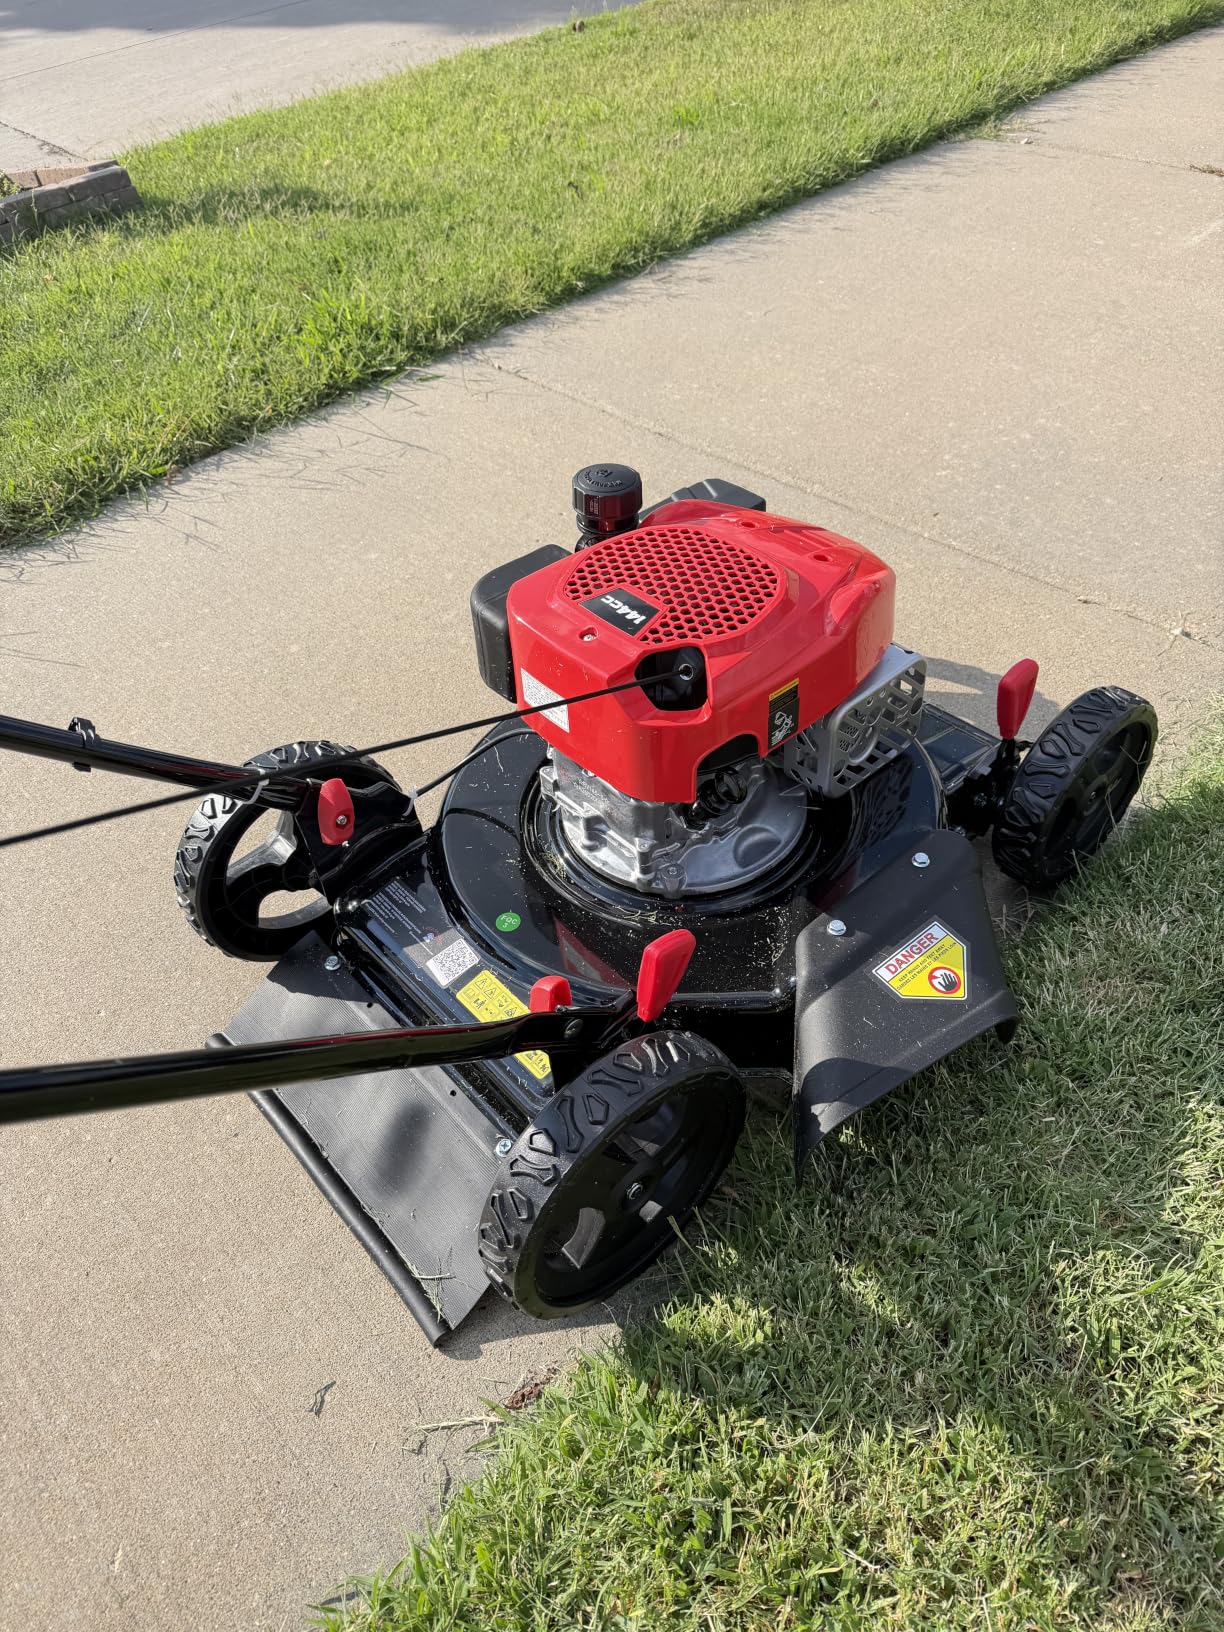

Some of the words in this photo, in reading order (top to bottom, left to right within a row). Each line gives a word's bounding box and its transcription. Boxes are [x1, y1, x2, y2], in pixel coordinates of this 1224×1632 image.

[600, 594, 647, 625] 144CC
[500, 915, 517, 924] FQC
[884, 932, 939, 975] DANGER
[899, 973, 907, 982] KEEP
[908, 964, 920, 974] HANDS
